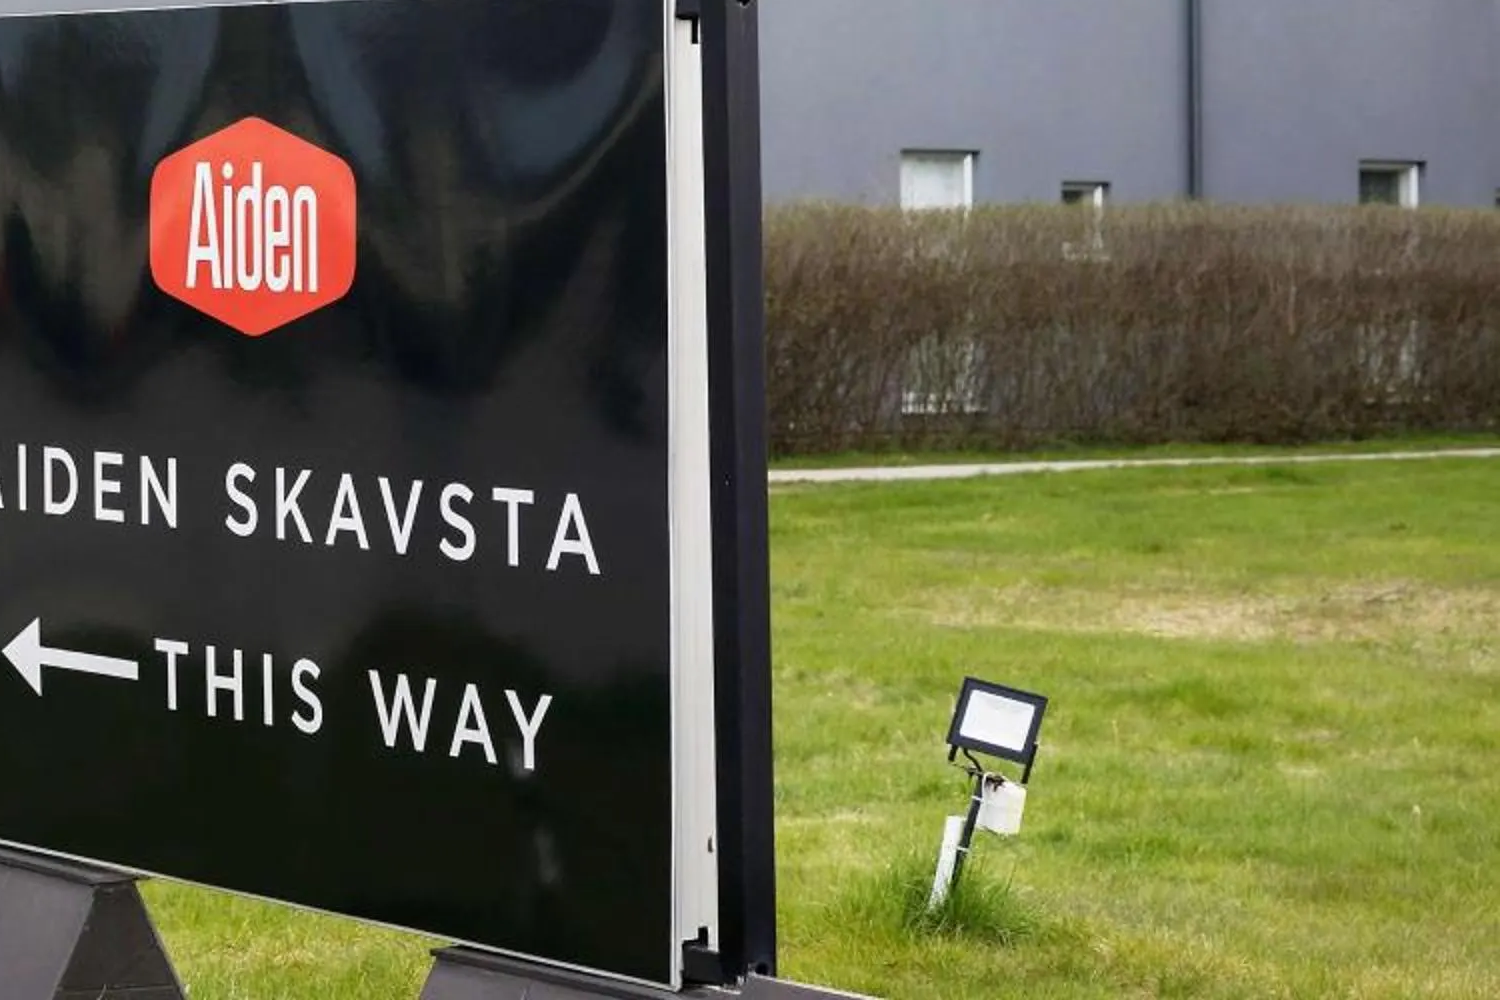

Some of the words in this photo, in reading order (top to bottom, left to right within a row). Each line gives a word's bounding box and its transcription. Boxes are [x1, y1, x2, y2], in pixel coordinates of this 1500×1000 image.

[186, 161, 318, 293] Aiden
[225, 463, 601, 575] SKAVSTA
[155, 638, 323, 734] THIS
[368, 669, 553, 770] WAY
